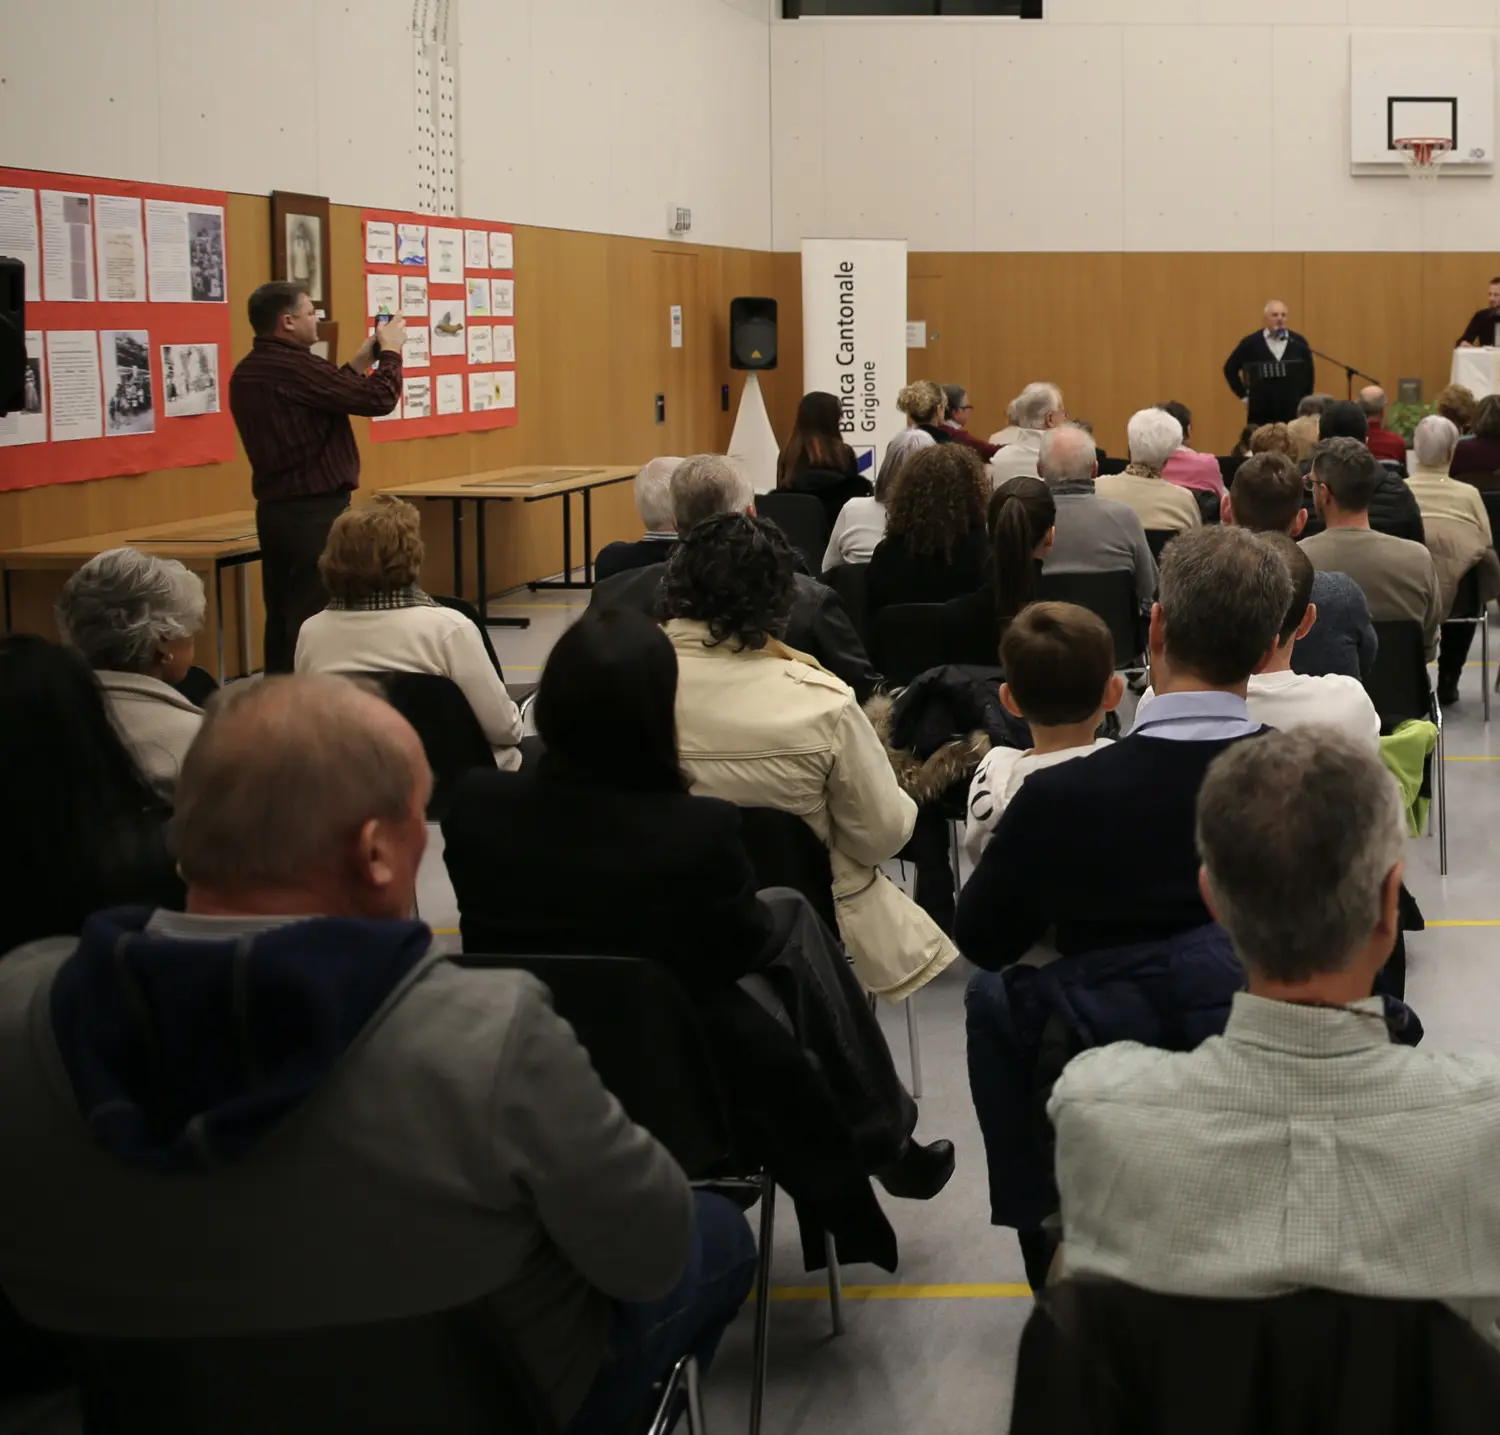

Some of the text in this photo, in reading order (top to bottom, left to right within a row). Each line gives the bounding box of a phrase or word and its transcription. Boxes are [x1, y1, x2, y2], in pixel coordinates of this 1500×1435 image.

[833, 261, 855, 433] Banca Cantonale
[860, 361, 880, 432] Grigione
